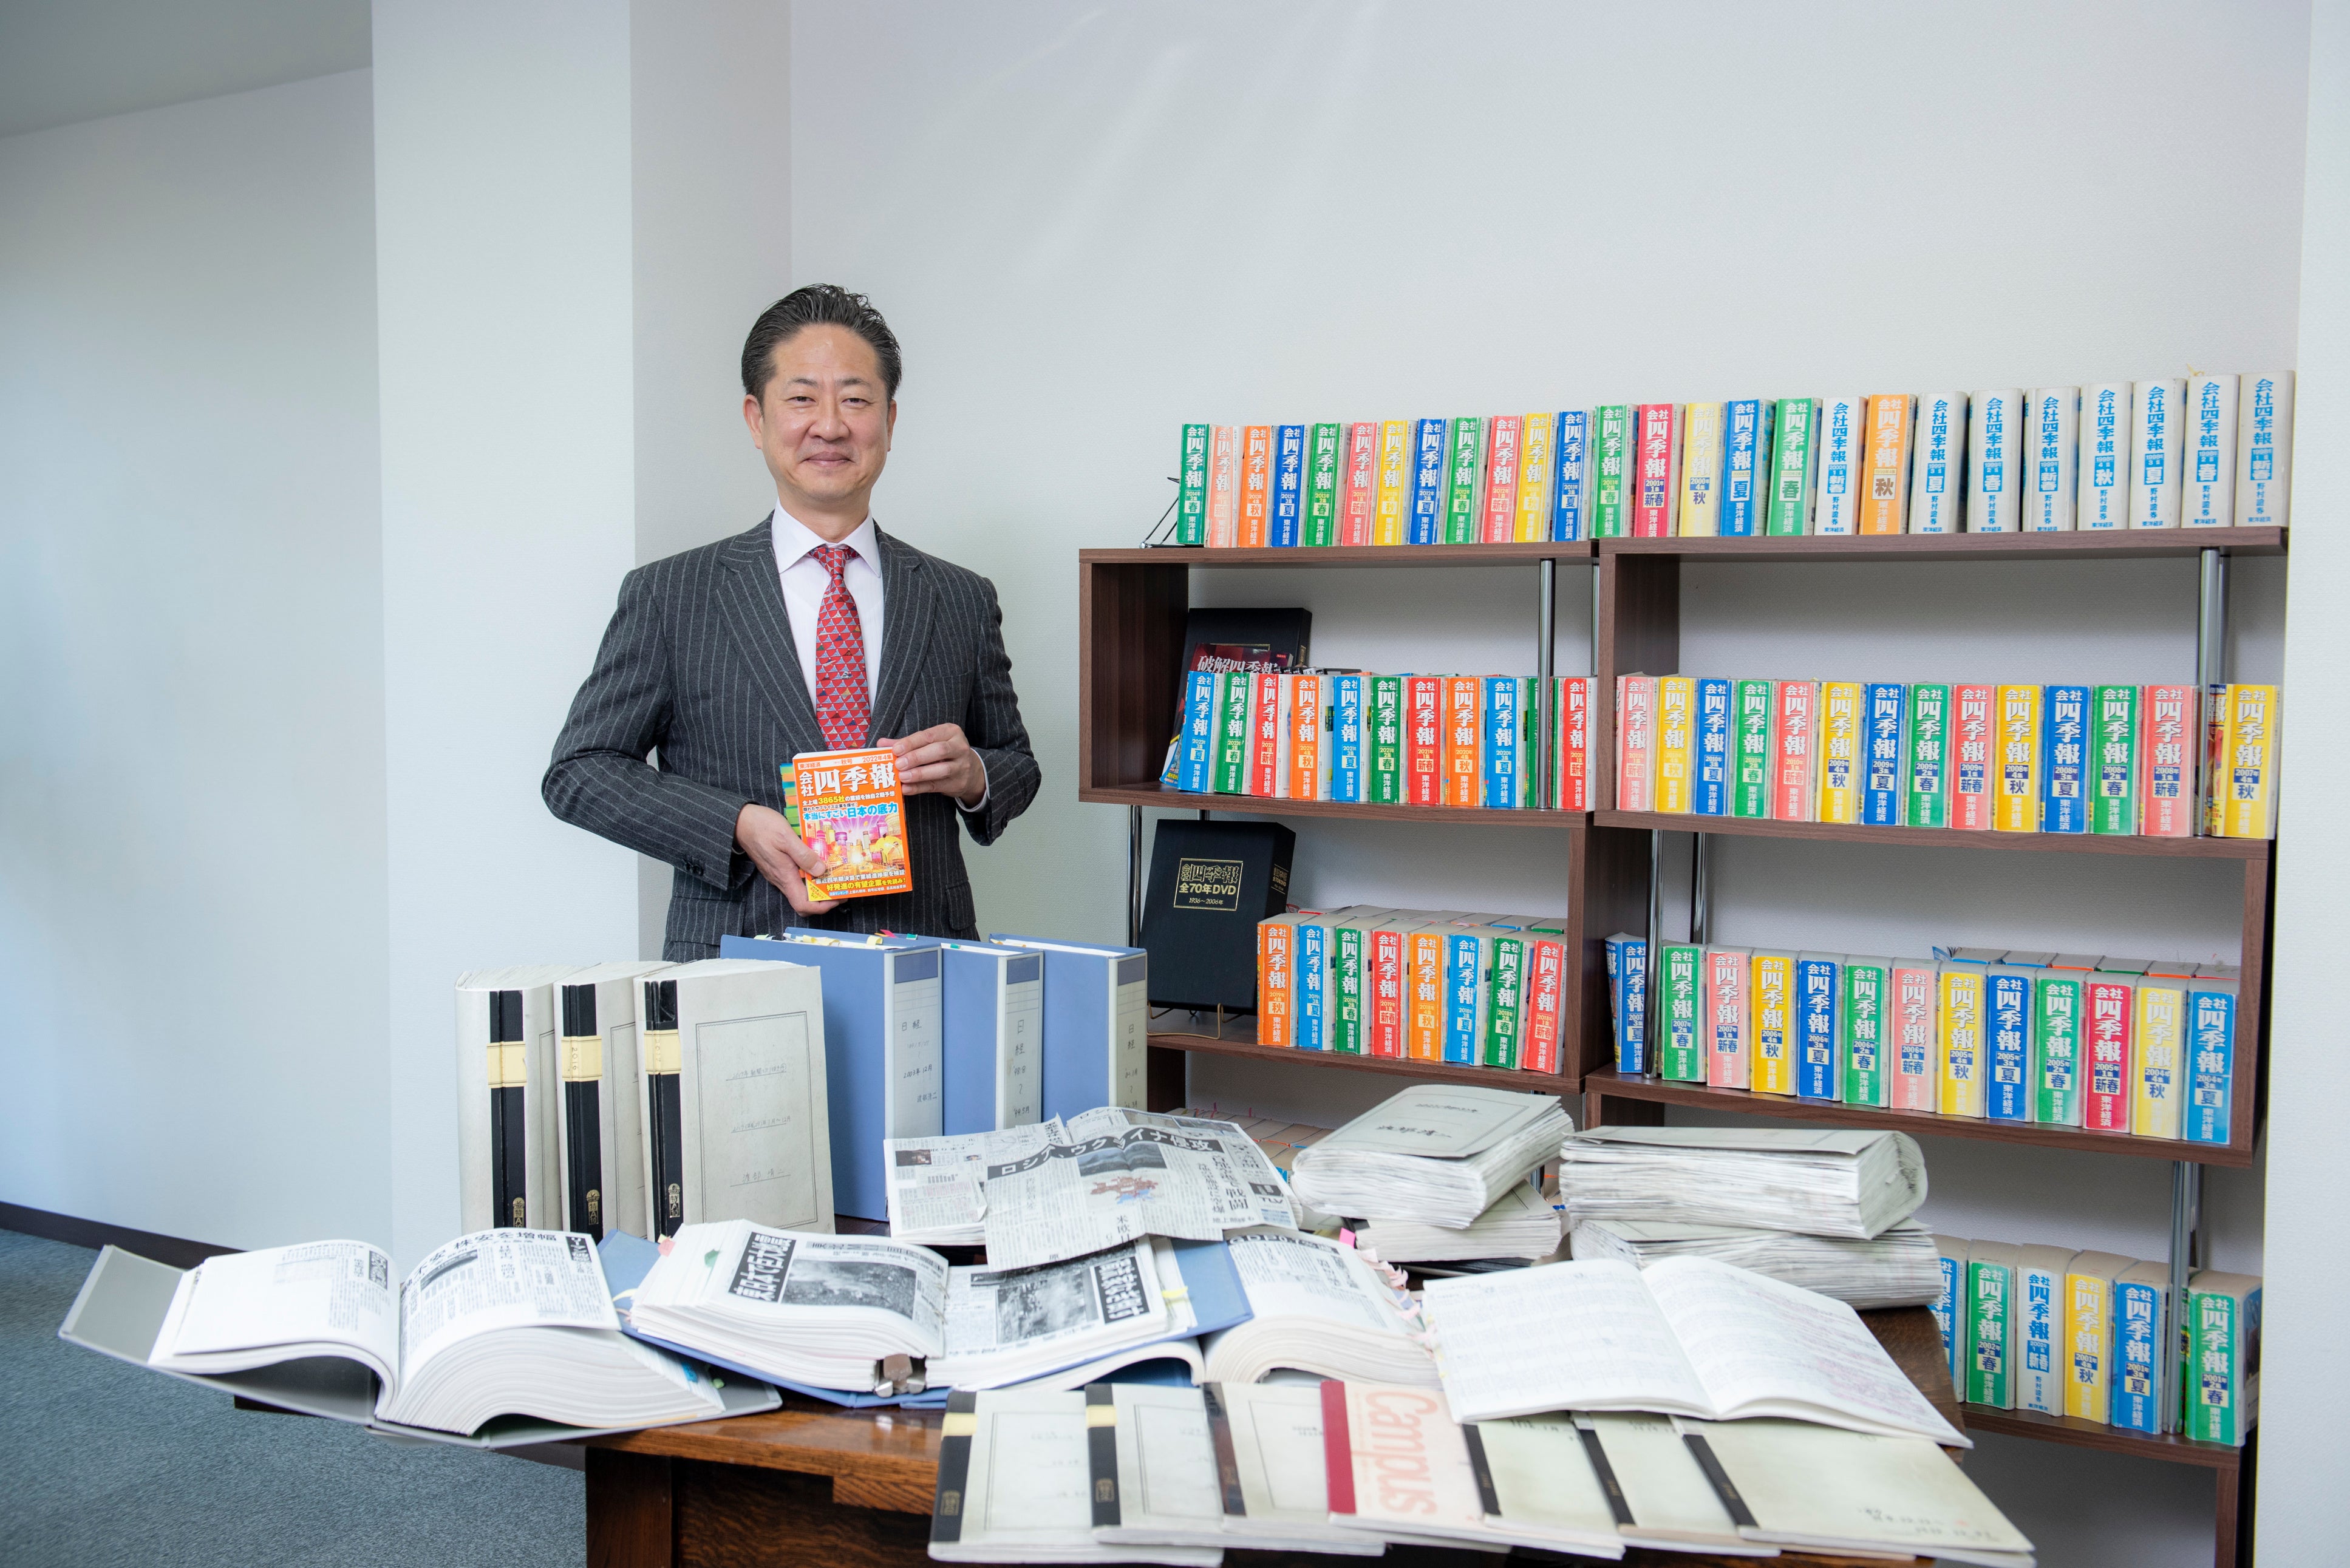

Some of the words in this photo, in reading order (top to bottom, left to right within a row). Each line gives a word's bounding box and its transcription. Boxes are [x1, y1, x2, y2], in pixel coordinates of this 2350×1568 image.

[1831, 402, 1849, 463] 会社四季報
[1930, 399, 1948, 460] 会社四季報
[1985, 398, 2003, 459] 会社四季報
[2040, 396, 2059, 459] 会社四季報
[2097, 389, 2115, 453] 会社四季報
[2147, 386, 2165, 451] 会社四季報
[2200, 382, 2220, 447] 会社四季報
[2253, 379, 2273, 445] 会社四季報
[814, 762, 896, 795] 四季報
[1961, 779, 1983, 793] 新春
[1179, 883, 1236, 895] 全70年DVD
[1717, 1039, 1737, 1053] 新春
[1350, 1391, 1438, 1515] Campus
